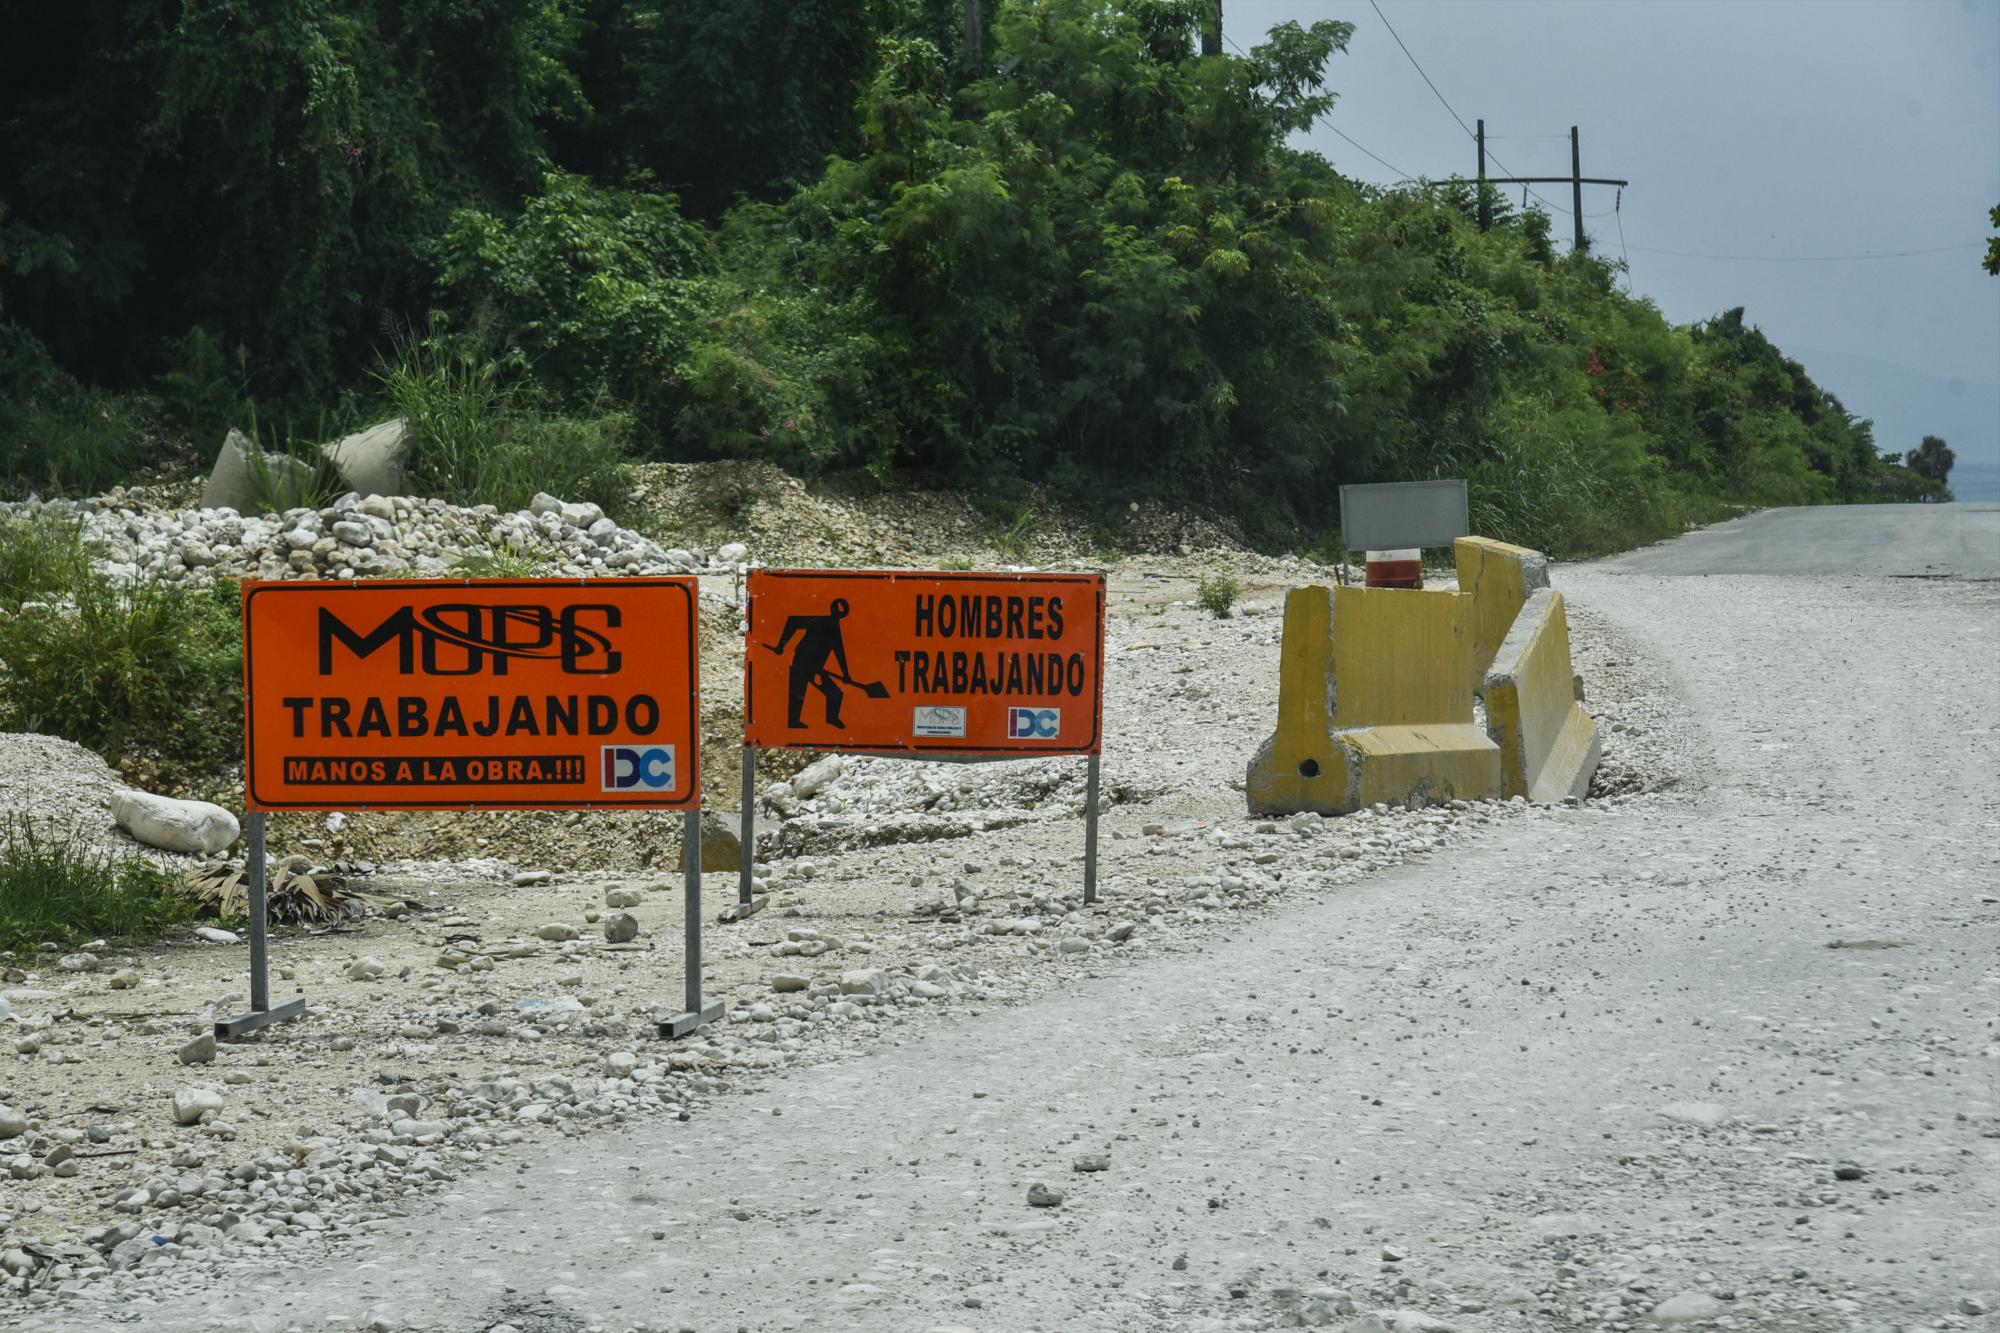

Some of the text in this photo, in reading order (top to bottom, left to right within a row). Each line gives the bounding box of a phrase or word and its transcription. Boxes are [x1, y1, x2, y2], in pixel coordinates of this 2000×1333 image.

[915, 593, 1065, 640] HOMBRES
[894, 650, 1086, 697] TRABAJANDO
[283, 694, 660, 737] TRABAJANDO
[1010, 708, 1058, 737] IDC
[288, 761, 386, 781] MANOS
[396, 761, 413, 781] A
[423, 761, 457, 781] LA
[605, 748, 672, 788] IDC
